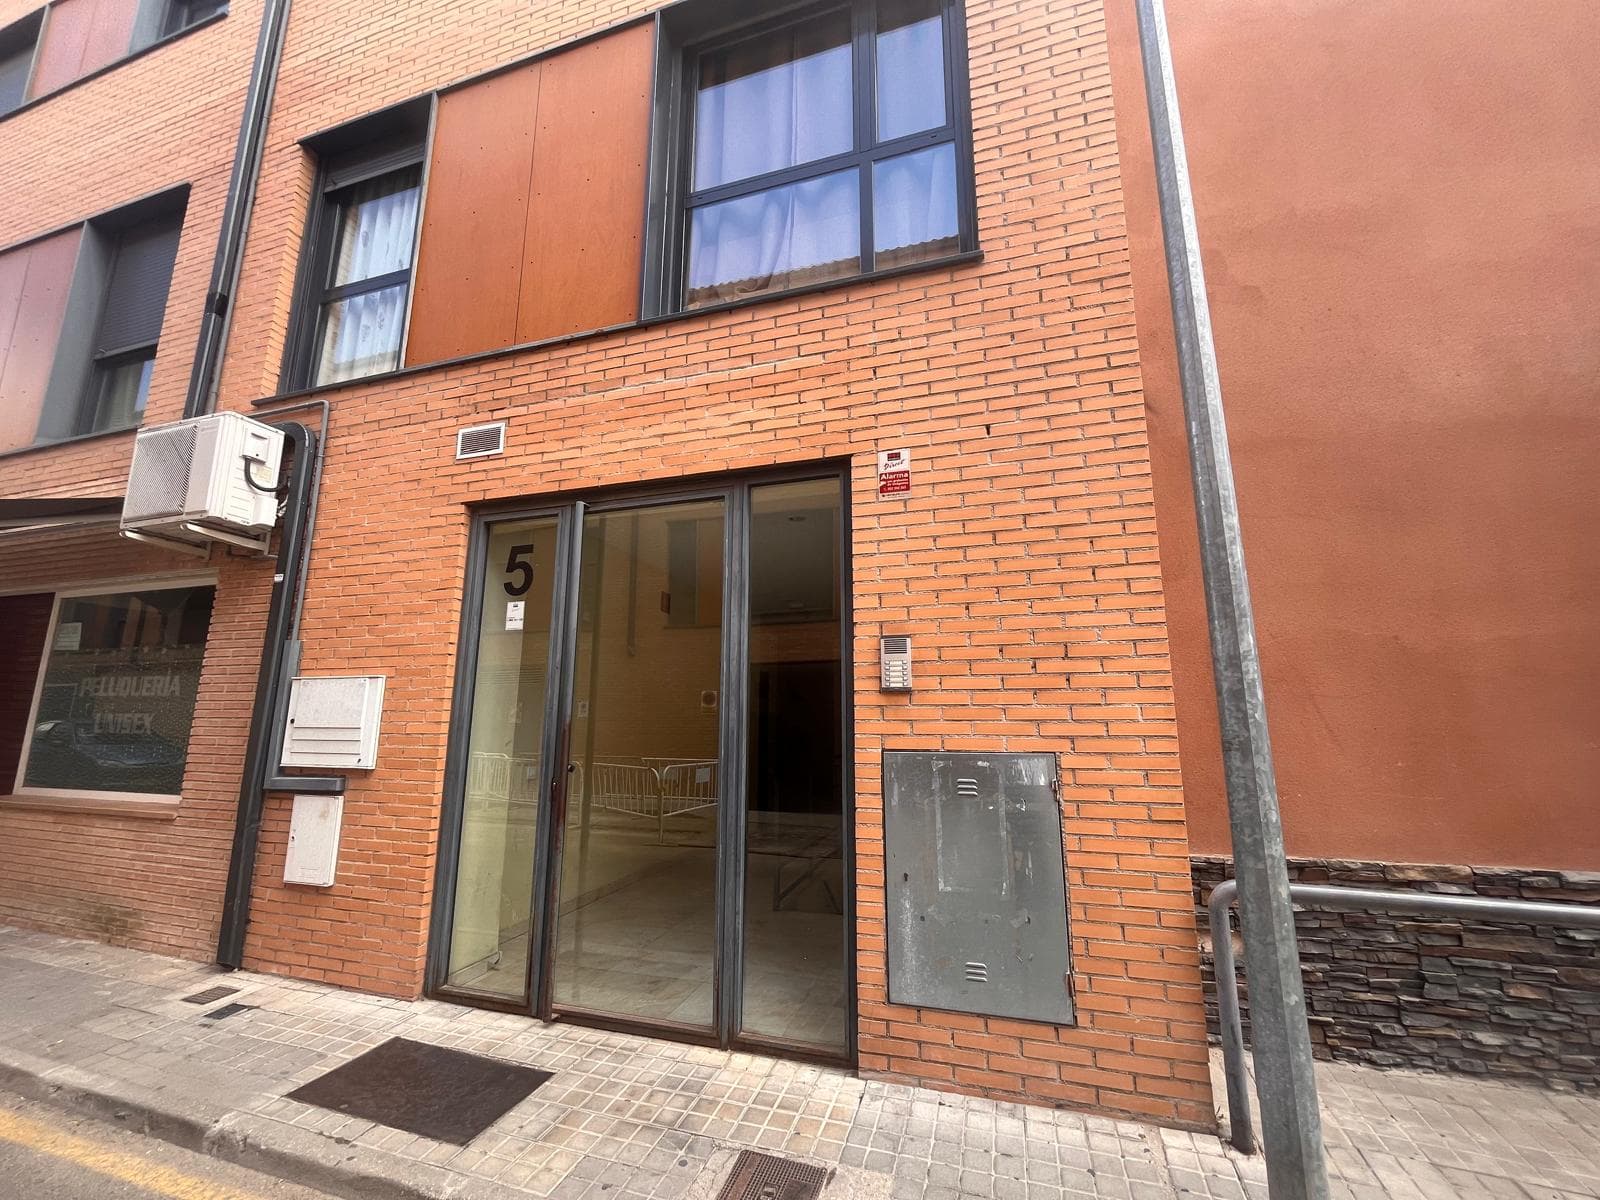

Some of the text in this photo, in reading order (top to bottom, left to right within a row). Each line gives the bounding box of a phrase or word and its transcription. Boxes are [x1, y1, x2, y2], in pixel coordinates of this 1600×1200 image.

[880, 472, 909, 480] Alarma
[504, 544, 534, 596] 5
[94, 713, 156, 735] UNISEX
